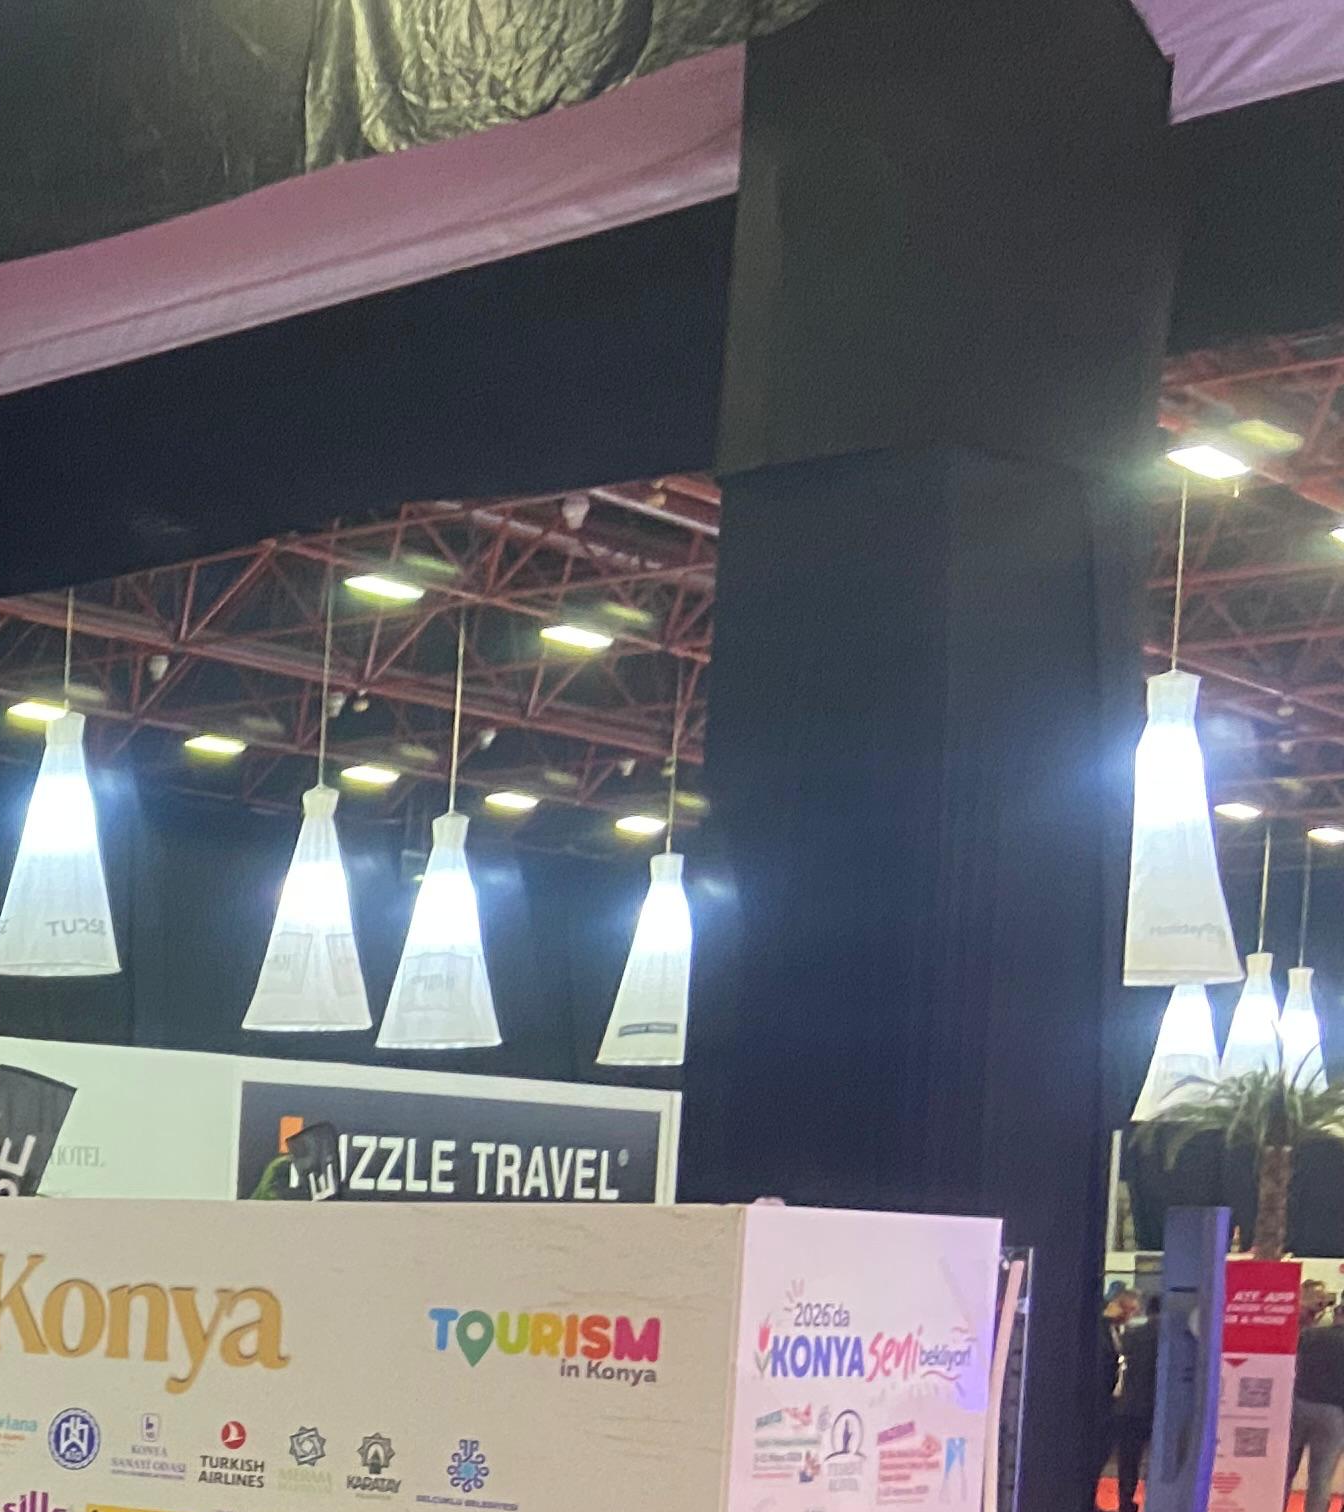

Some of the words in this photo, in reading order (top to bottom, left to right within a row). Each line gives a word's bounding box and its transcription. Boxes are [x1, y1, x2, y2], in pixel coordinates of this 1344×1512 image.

[473, 1141, 617, 1200] TRAVEL
[428, 1307, 661, 1368] TOURISM
[560, 1359, 580, 1379] in
[587, 1360, 658, 1387] Konya
[771, 1334, 865, 1378] KONYA
[198, 1470, 265, 1488] AIRLINES
[200, 1455, 265, 1472] TURKISH
